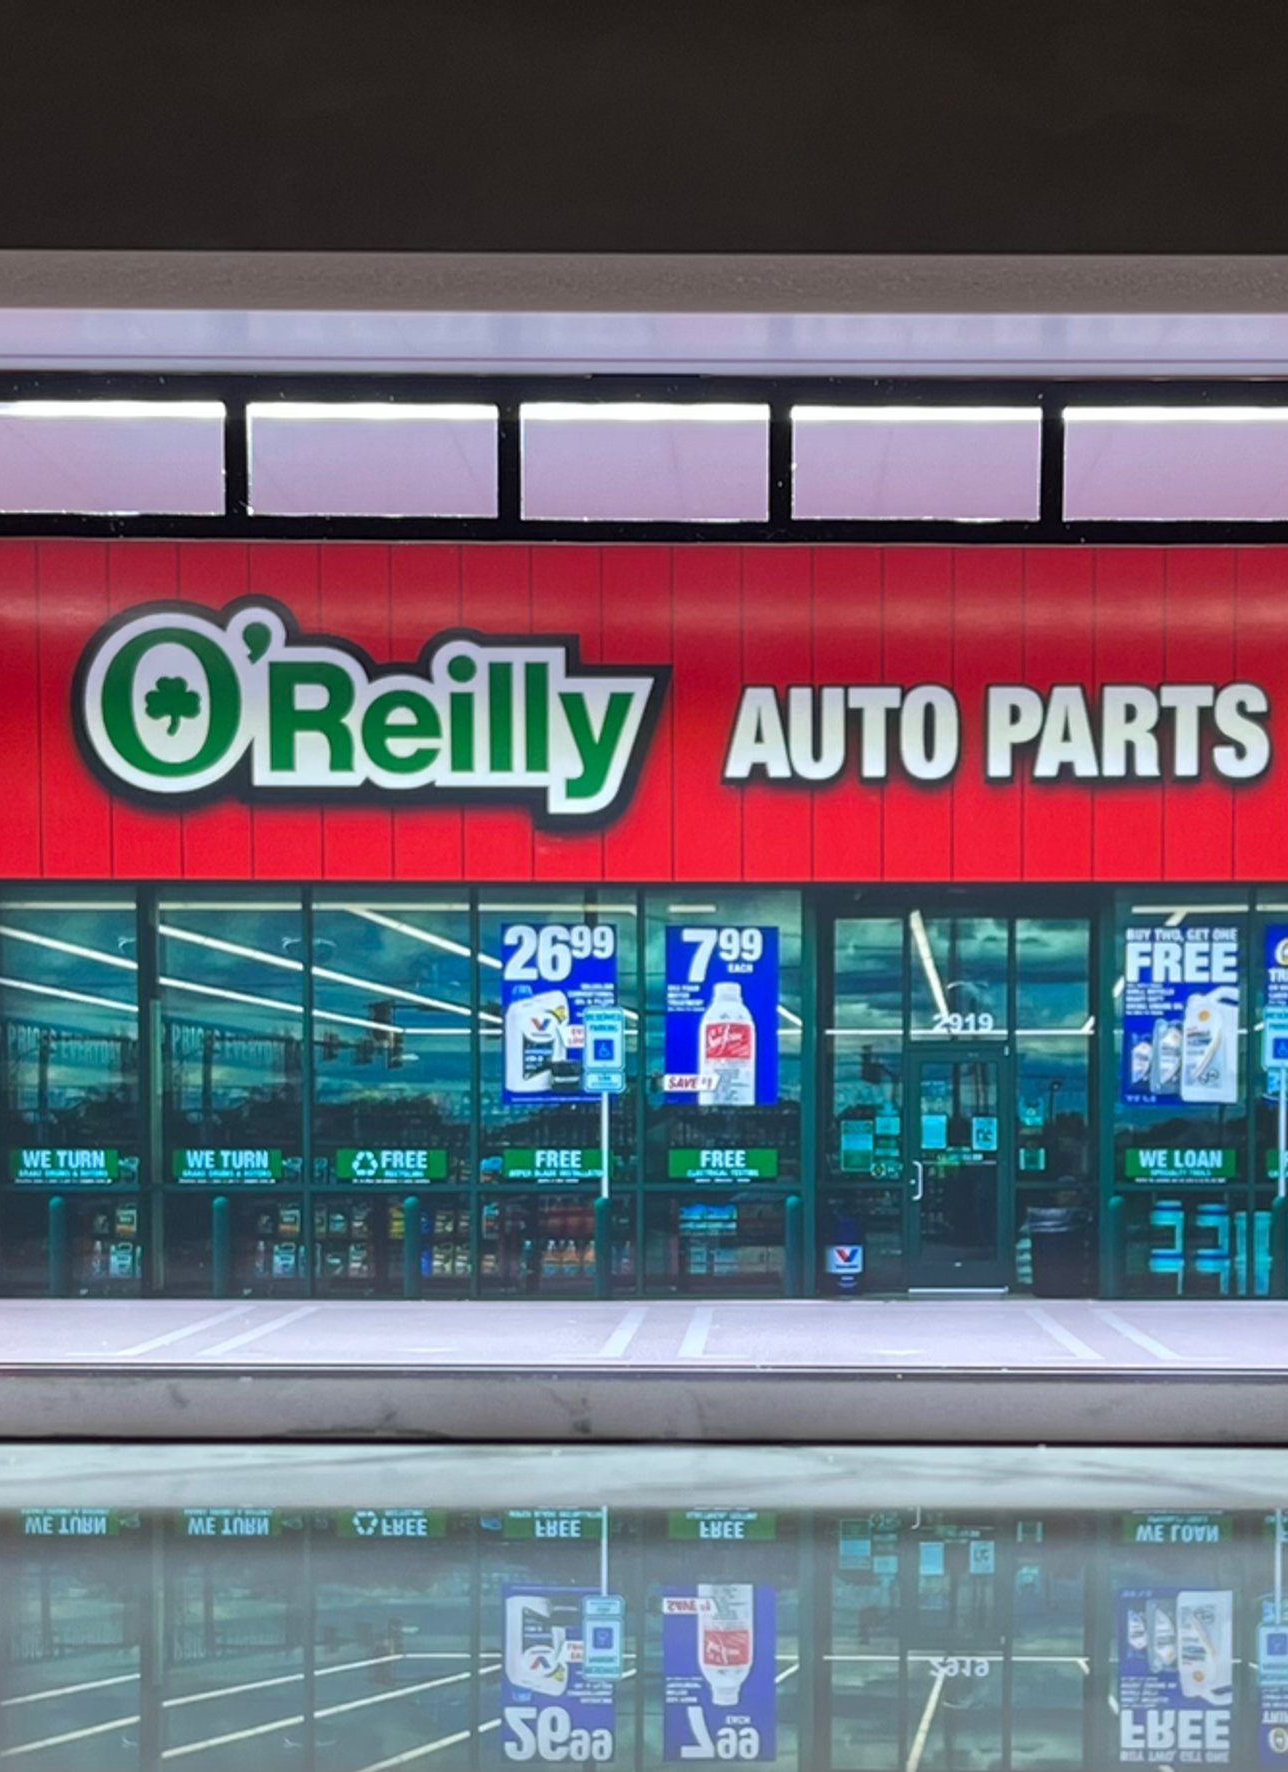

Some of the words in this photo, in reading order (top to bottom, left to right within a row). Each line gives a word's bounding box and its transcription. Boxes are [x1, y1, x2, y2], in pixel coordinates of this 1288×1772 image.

[98, 620, 635, 800] O'Reilly
[721, 685, 960, 781] AUTO
[985, 683, 1272, 780] PARTS
[1125, 928, 1151, 941] BUY
[1154, 928, 1184, 942] TWO,
[1186, 928, 1210, 941] GET
[1212, 928, 1238, 941] ONE
[1125, 942, 1239, 983] FREE
[931, 1012, 994, 1034] 2919
[667, 1076, 697, 1090] SAVE
[22, 1150, 51, 1168] WE
[55, 1150, 106, 1168] TURN
[186, 1150, 215, 1168] WE
[219, 1150, 269, 1168] TURN
[380, 1149, 428, 1169] FREE
[535, 1149, 582, 1169] FREE
[699, 1149, 747, 1168] FREE
[1138, 1150, 1168, 1168] WE
[1173, 1150, 1223, 1168] LOAN
